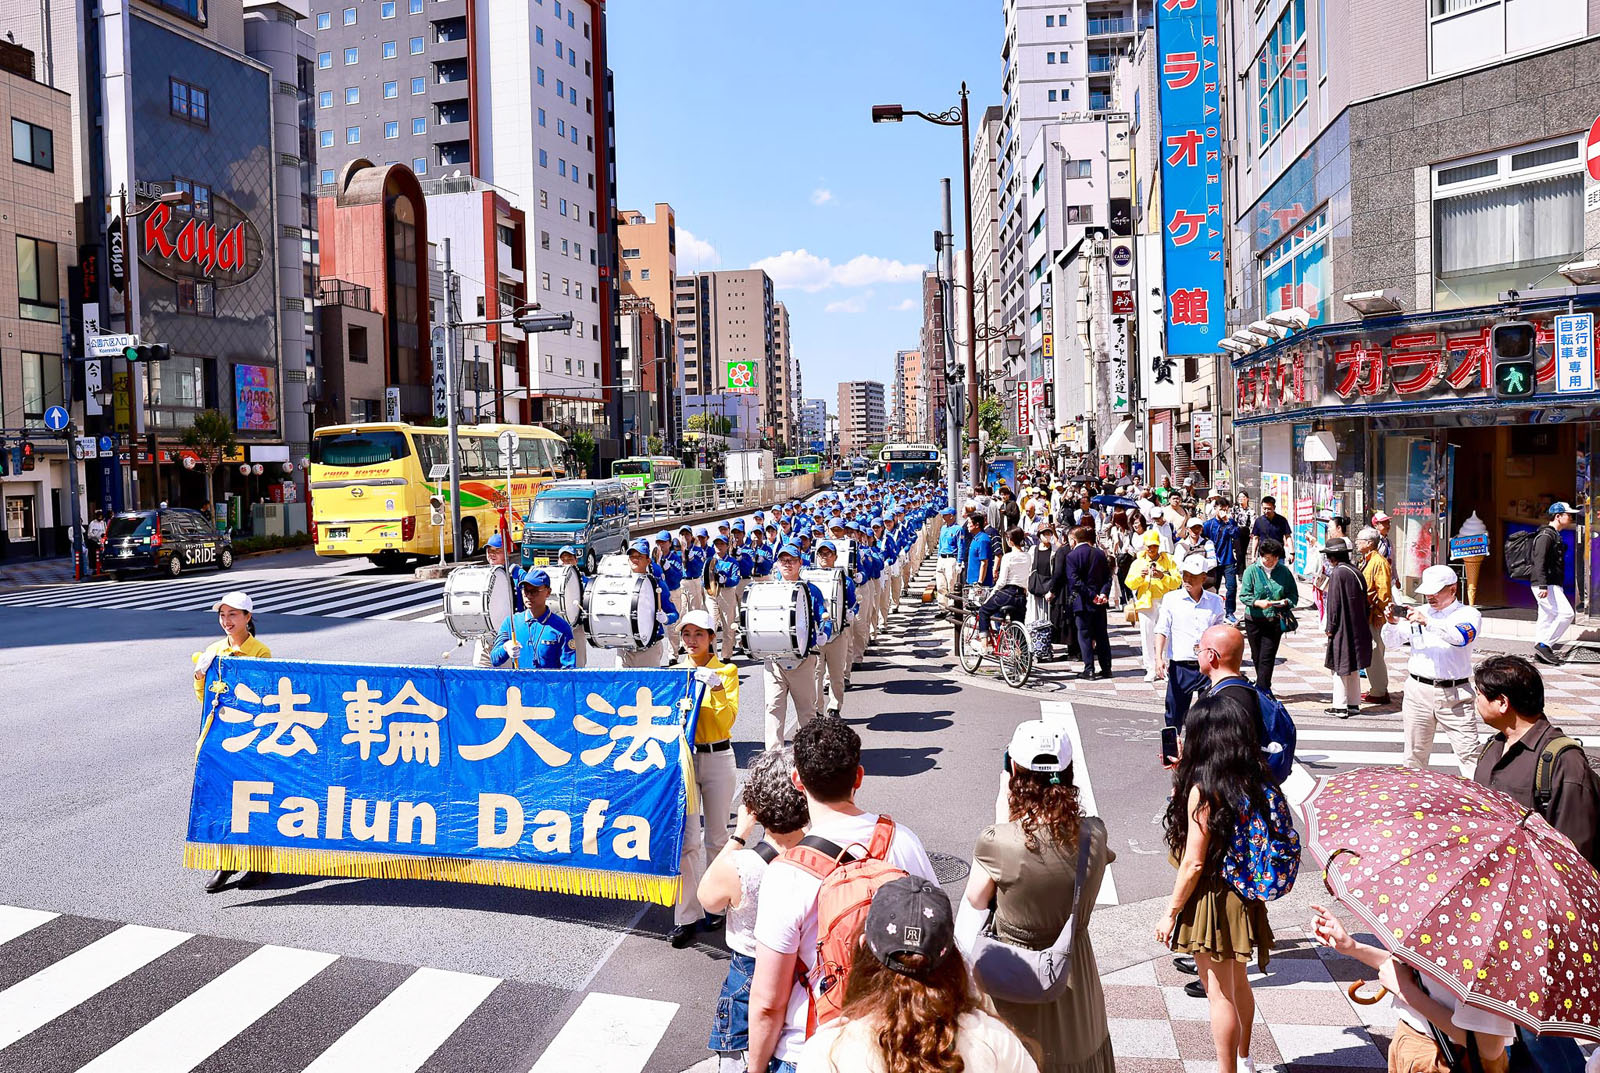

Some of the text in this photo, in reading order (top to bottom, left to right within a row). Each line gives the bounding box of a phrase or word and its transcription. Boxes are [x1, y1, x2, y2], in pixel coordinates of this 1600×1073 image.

[1203, 35, 1222, 262] KARAOKE KAN
[111, 231, 124, 278] Royal
[145, 203, 246, 277] Royal
[85, 318, 101, 401] 浅今半
[1112, 315, 1127, 394] まるごと北海道
[1560, 320, 1574, 359] 自転車
[1569, 361, 1582, 388] 専用
[1575, 319, 1589, 358] 歩行者
[185, 547, 216, 565] S.RIDE
[221, 677, 683, 774] 法輪大法
[231, 780, 652, 861] Falun Dafa
